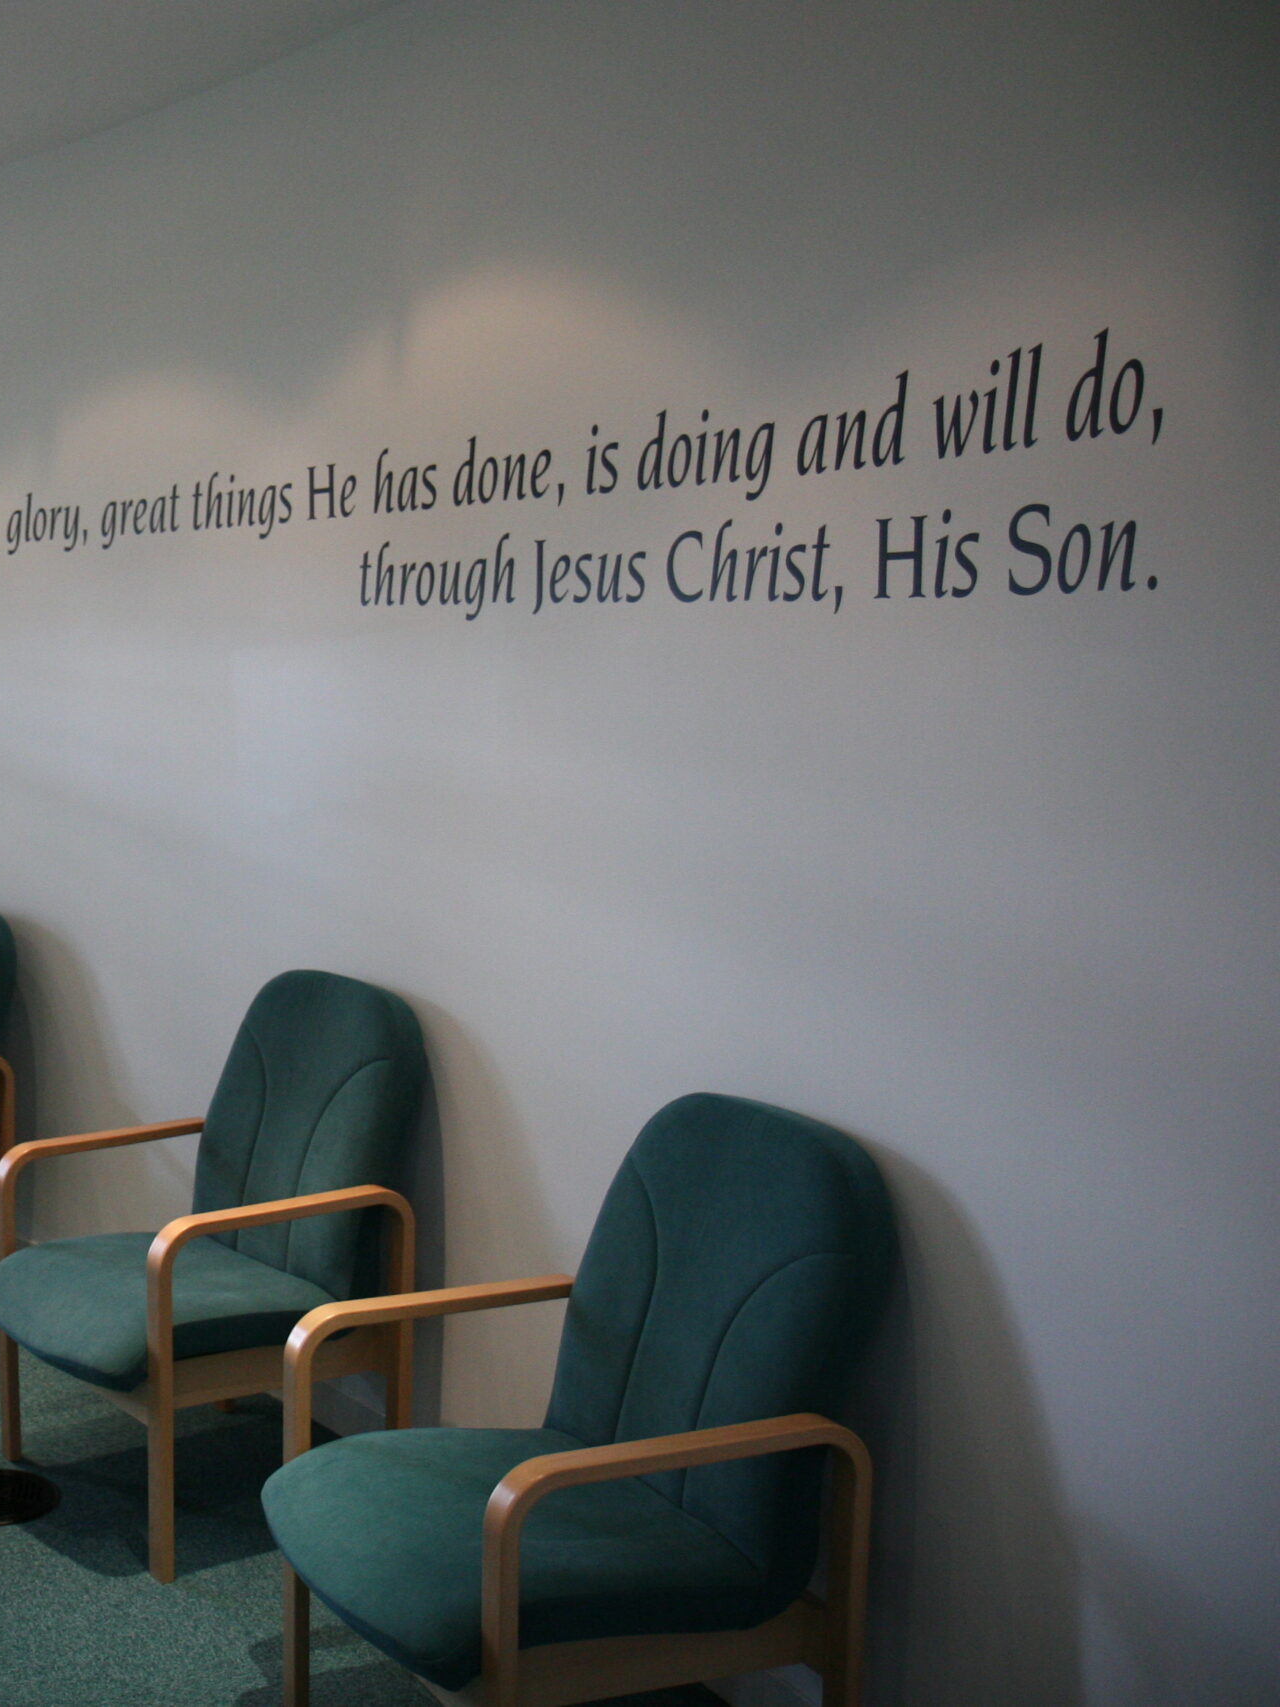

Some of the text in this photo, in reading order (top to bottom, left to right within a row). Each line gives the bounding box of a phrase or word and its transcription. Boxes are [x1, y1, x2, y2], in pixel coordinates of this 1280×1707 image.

[7, 493, 88, 555] glory,
[101, 484, 179, 550] great
[193, 472, 293, 539] things
[307, 463, 357, 520] He
[374, 448, 438, 513] has
[453, 436, 565, 507] done,
[586, 424, 619, 495] is
[637, 409, 775, 501] doing
[797, 370, 909, 476] and
[933, 343, 1042, 459] will
[1066, 328, 1164, 443] do,
[359, 503, 1159, 621] through Jesus Christ, His Son.
